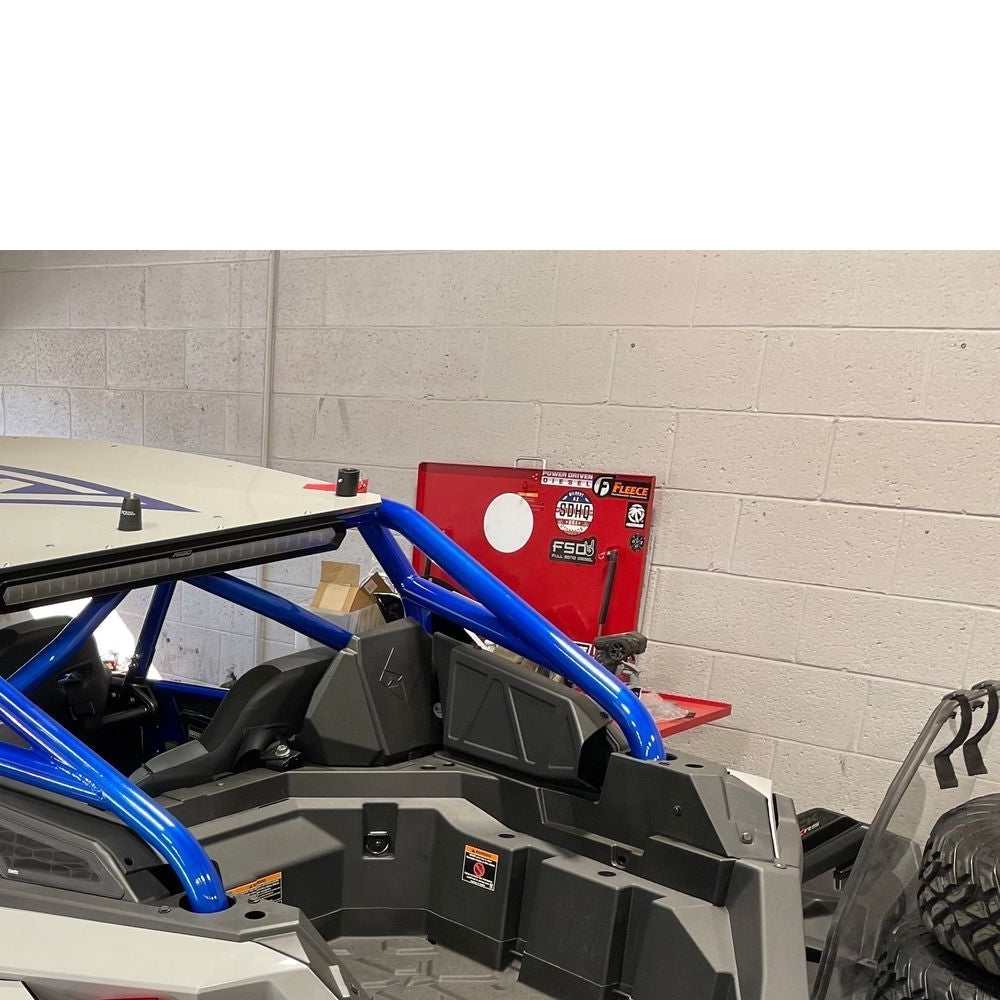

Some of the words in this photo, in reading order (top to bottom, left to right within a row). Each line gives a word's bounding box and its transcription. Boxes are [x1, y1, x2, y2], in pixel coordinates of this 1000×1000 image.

[542, 470, 568, 478] POWER
[568, 472, 594, 480] DRIVEN
[543, 478, 591, 487] DIESEL
[612, 481, 649, 496] FLEECE
[560, 503, 590, 520] SDHQ
